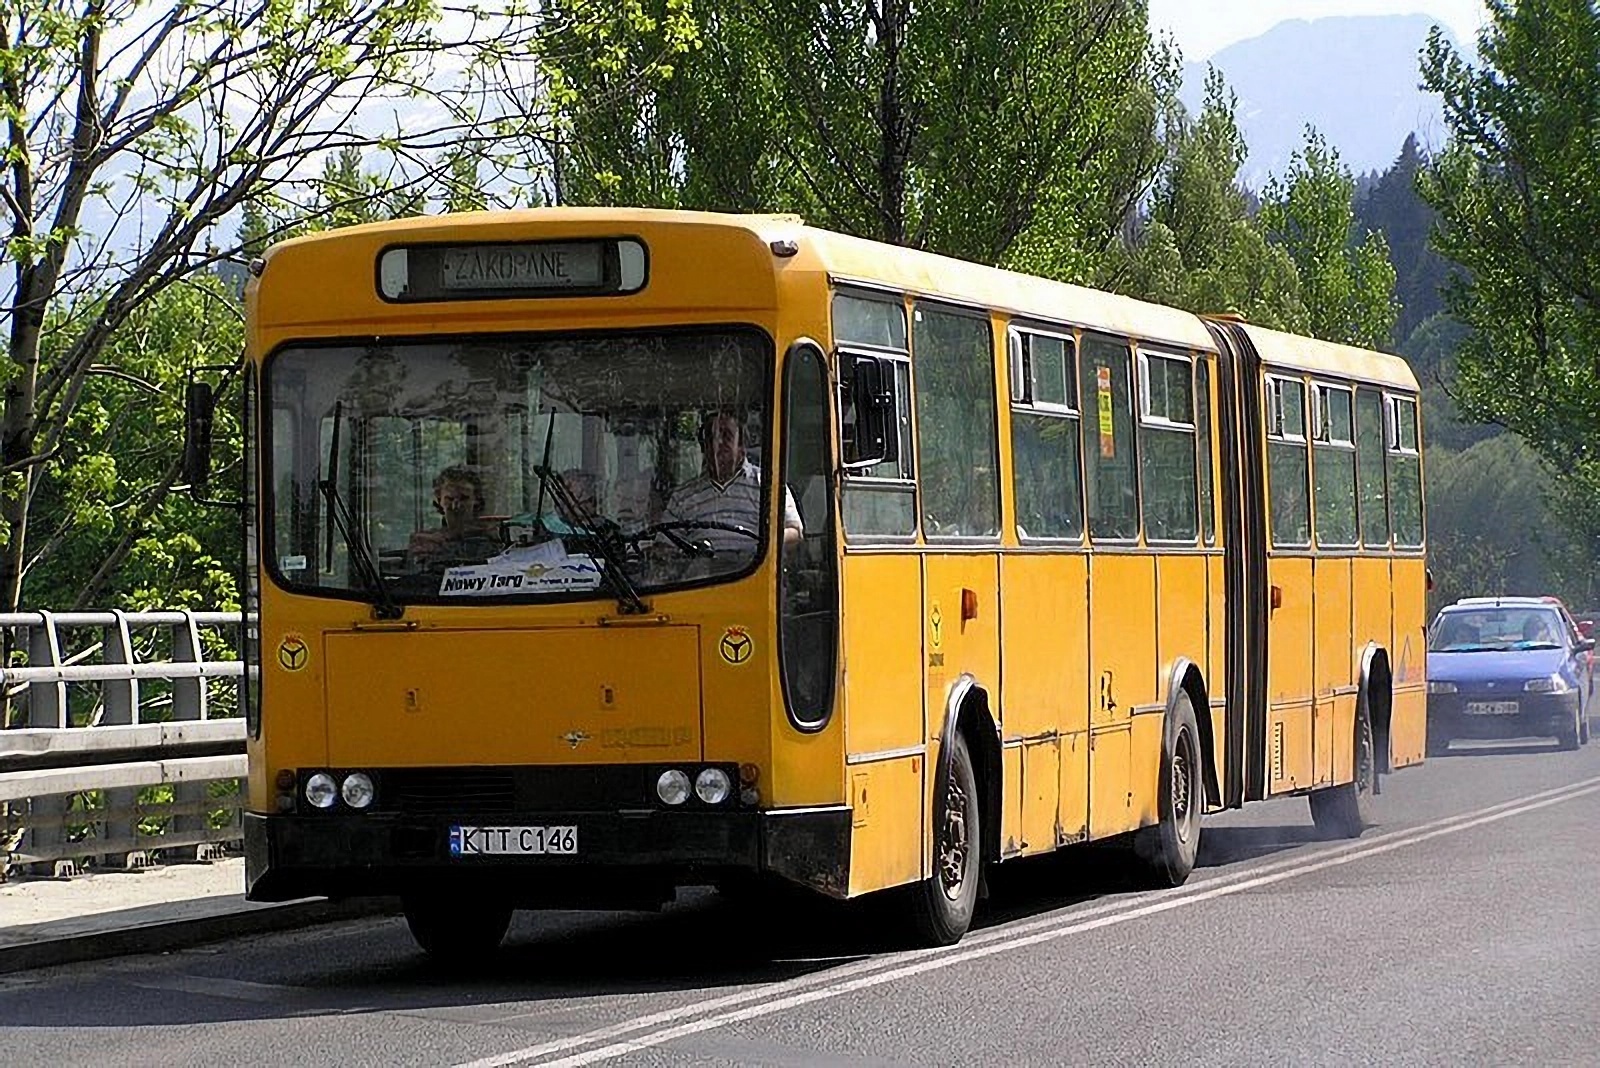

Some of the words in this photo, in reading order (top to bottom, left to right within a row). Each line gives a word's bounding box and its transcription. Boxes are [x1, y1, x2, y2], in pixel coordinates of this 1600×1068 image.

[455, 251, 570, 280] ZAKOPANE
[443, 577, 487, 591] Nowy
[463, 829, 511, 851] KTT
[519, 829, 575, 851] C146
